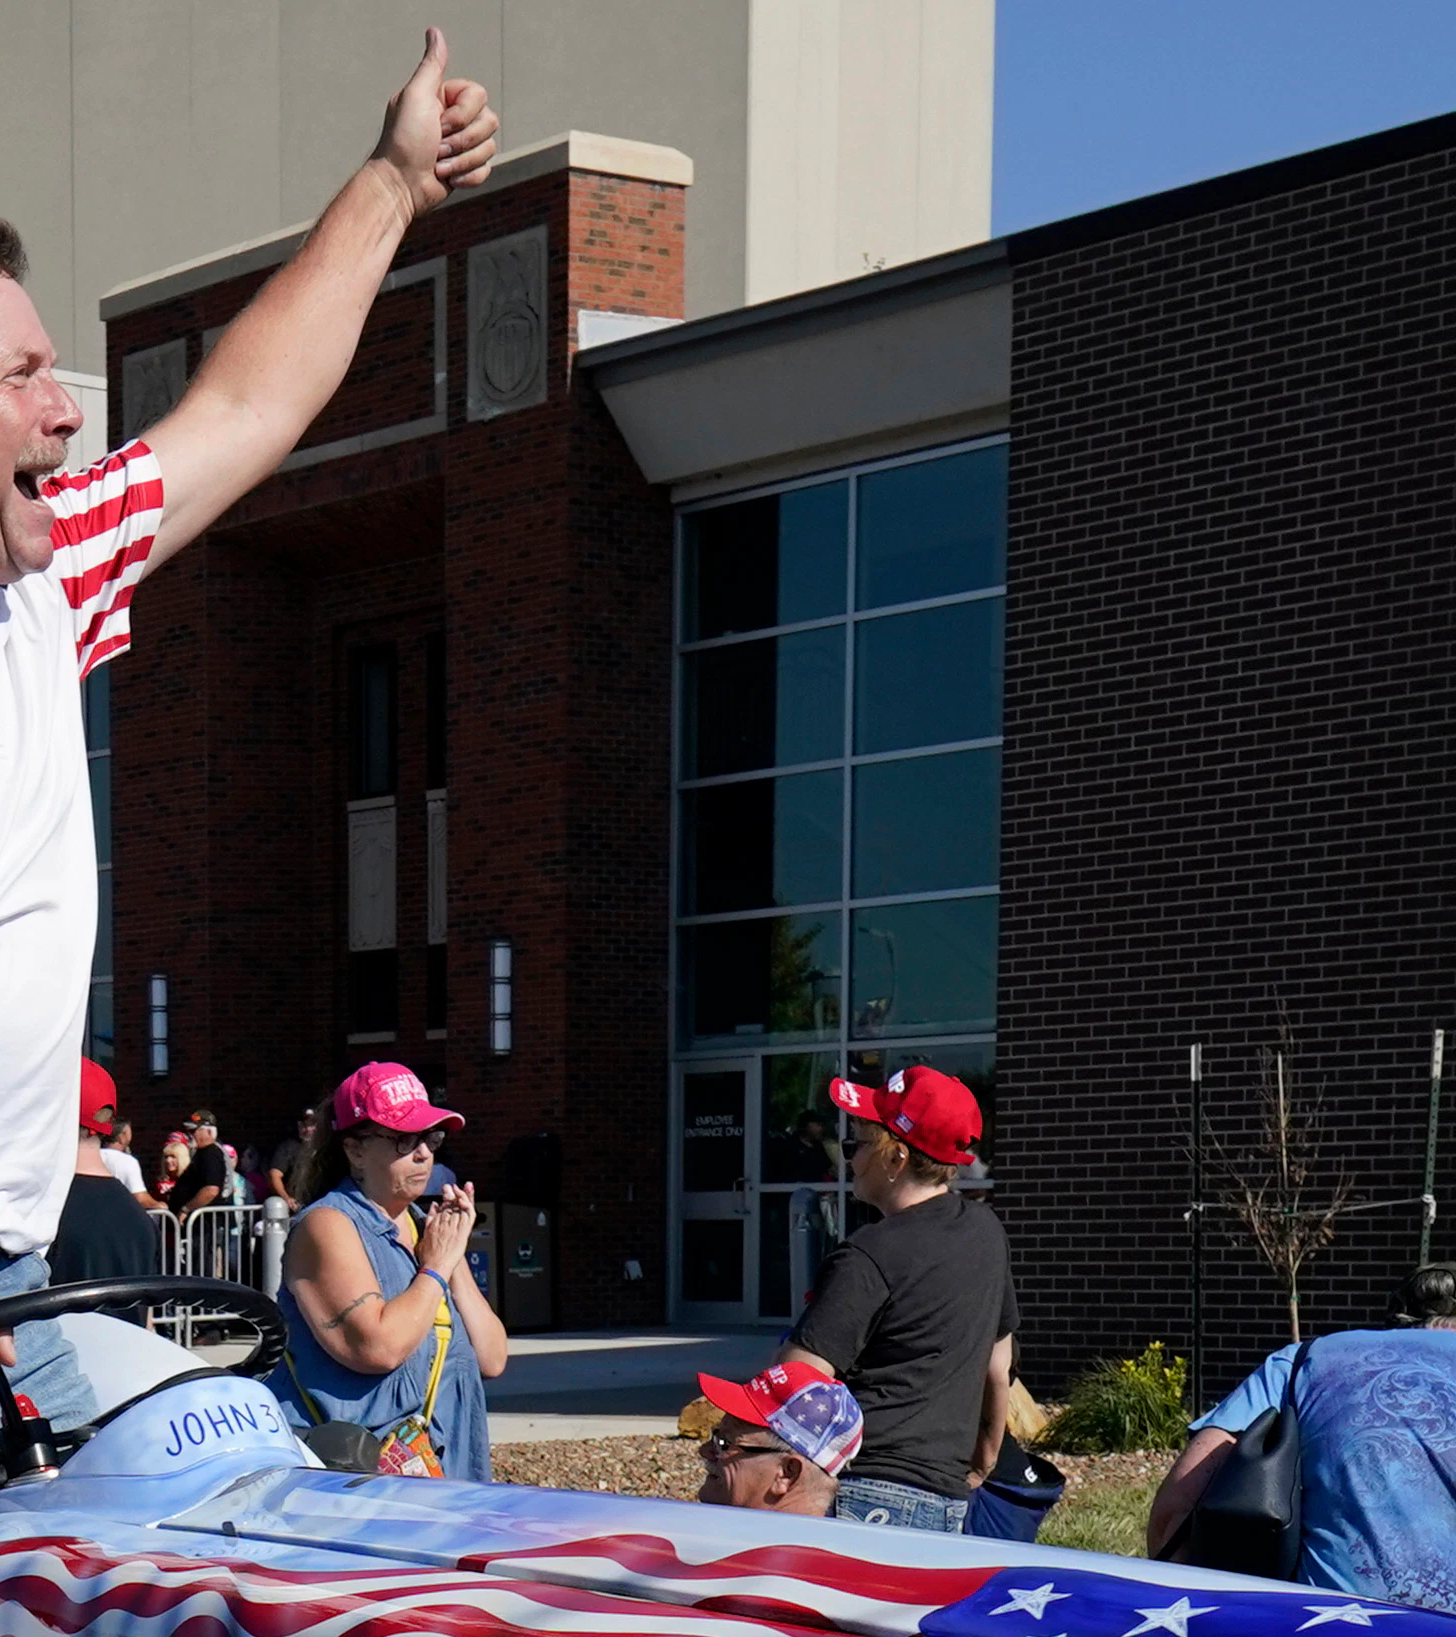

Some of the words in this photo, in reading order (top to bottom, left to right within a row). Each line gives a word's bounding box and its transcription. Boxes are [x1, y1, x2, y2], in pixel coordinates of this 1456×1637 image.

[695, 1115, 734, 1126] EMPLOYEE
[685, 1127, 723, 1138] ENTRANCE
[725, 1126, 743, 1137] ONLY
[166, 1403, 258, 1456] JOHN
